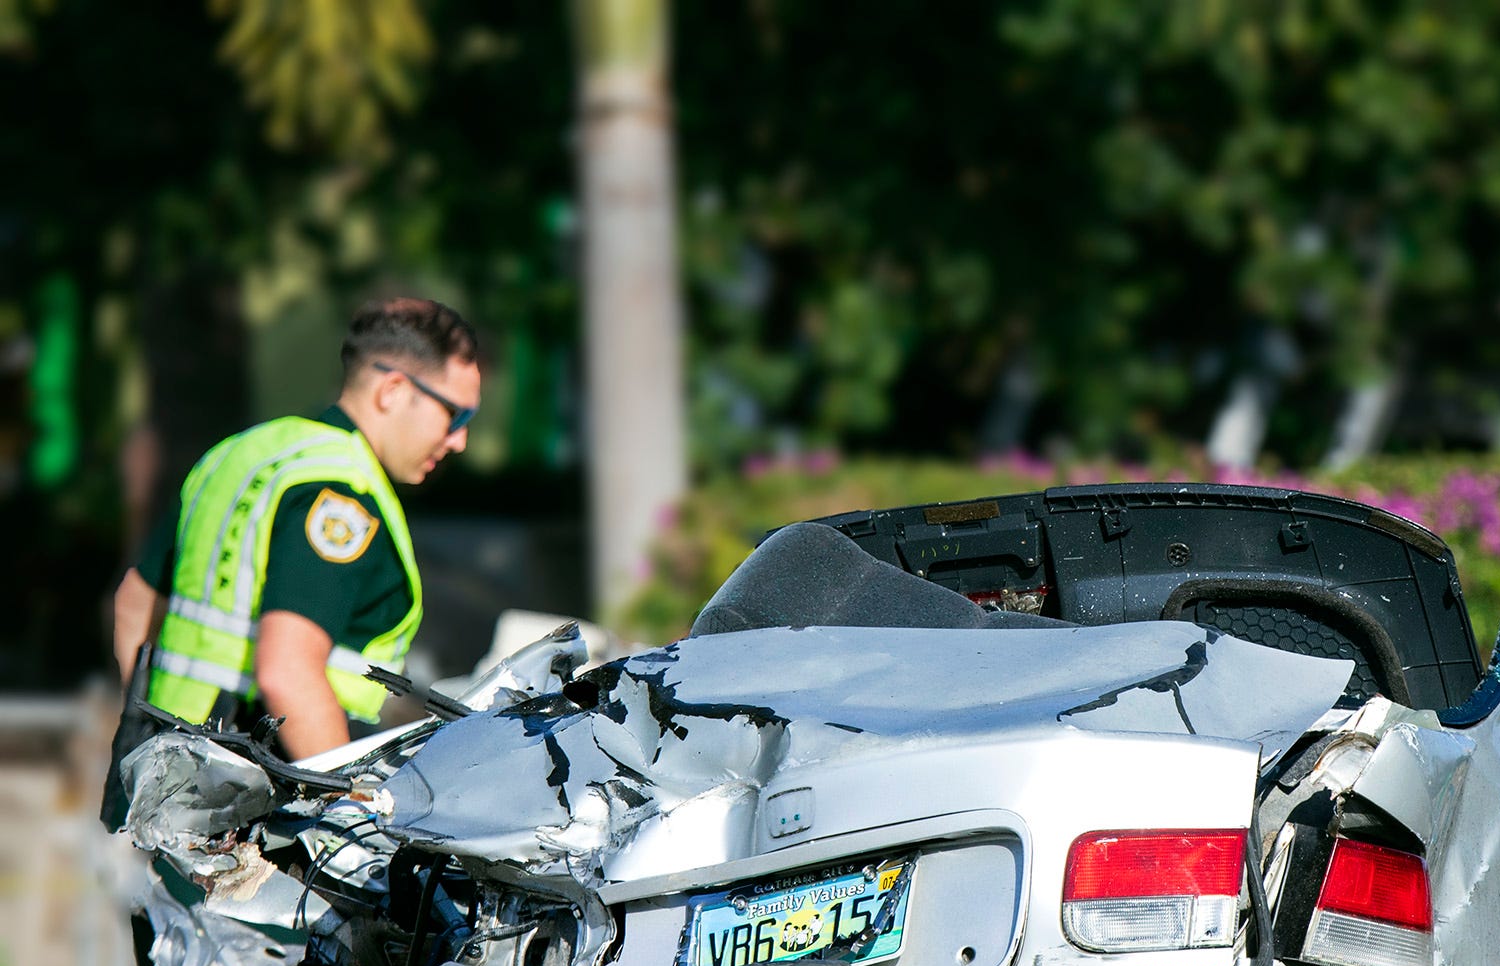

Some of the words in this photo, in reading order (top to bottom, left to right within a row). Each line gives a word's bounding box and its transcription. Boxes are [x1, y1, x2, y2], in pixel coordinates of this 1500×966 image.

[754, 874, 816, 894] GOTHAM
[822, 864, 855, 878] CITY
[747, 893, 805, 919] Family
[809, 883, 865, 904] Values
